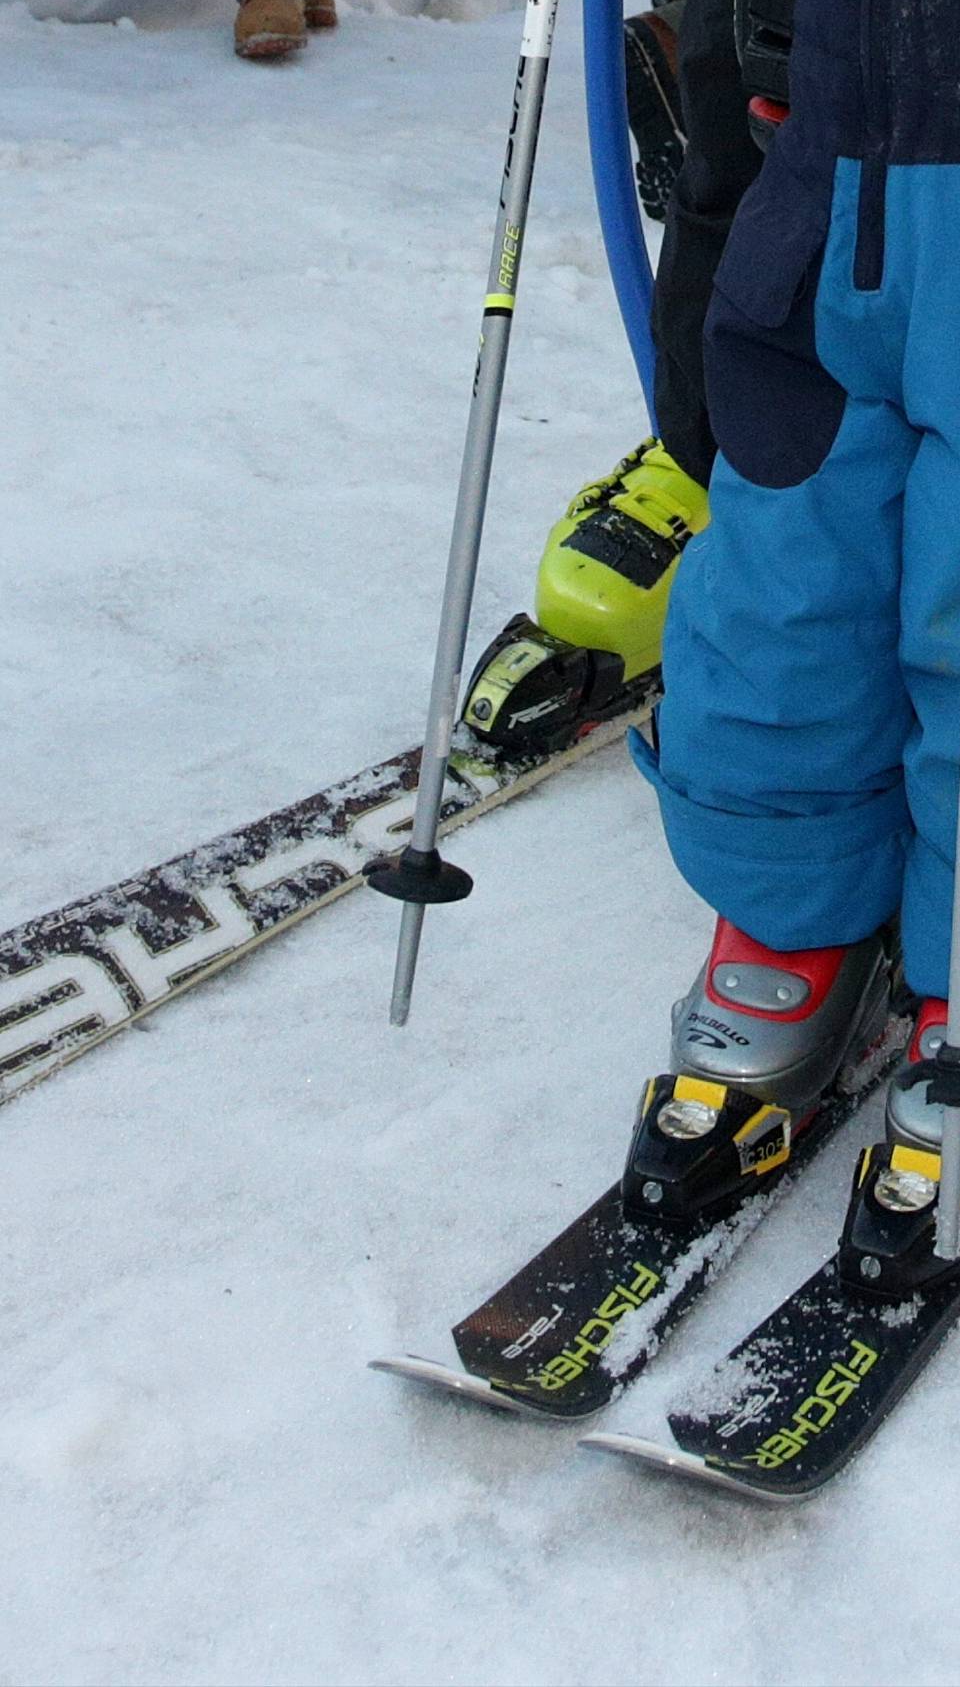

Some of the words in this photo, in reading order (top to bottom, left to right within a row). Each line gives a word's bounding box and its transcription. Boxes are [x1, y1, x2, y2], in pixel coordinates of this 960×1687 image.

[498, 218, 521, 290] RACE
[500, 1302, 564, 1359] race
[526, 1260, 661, 1392] FISCHER
[743, 1339, 878, 1470] FISCHER
